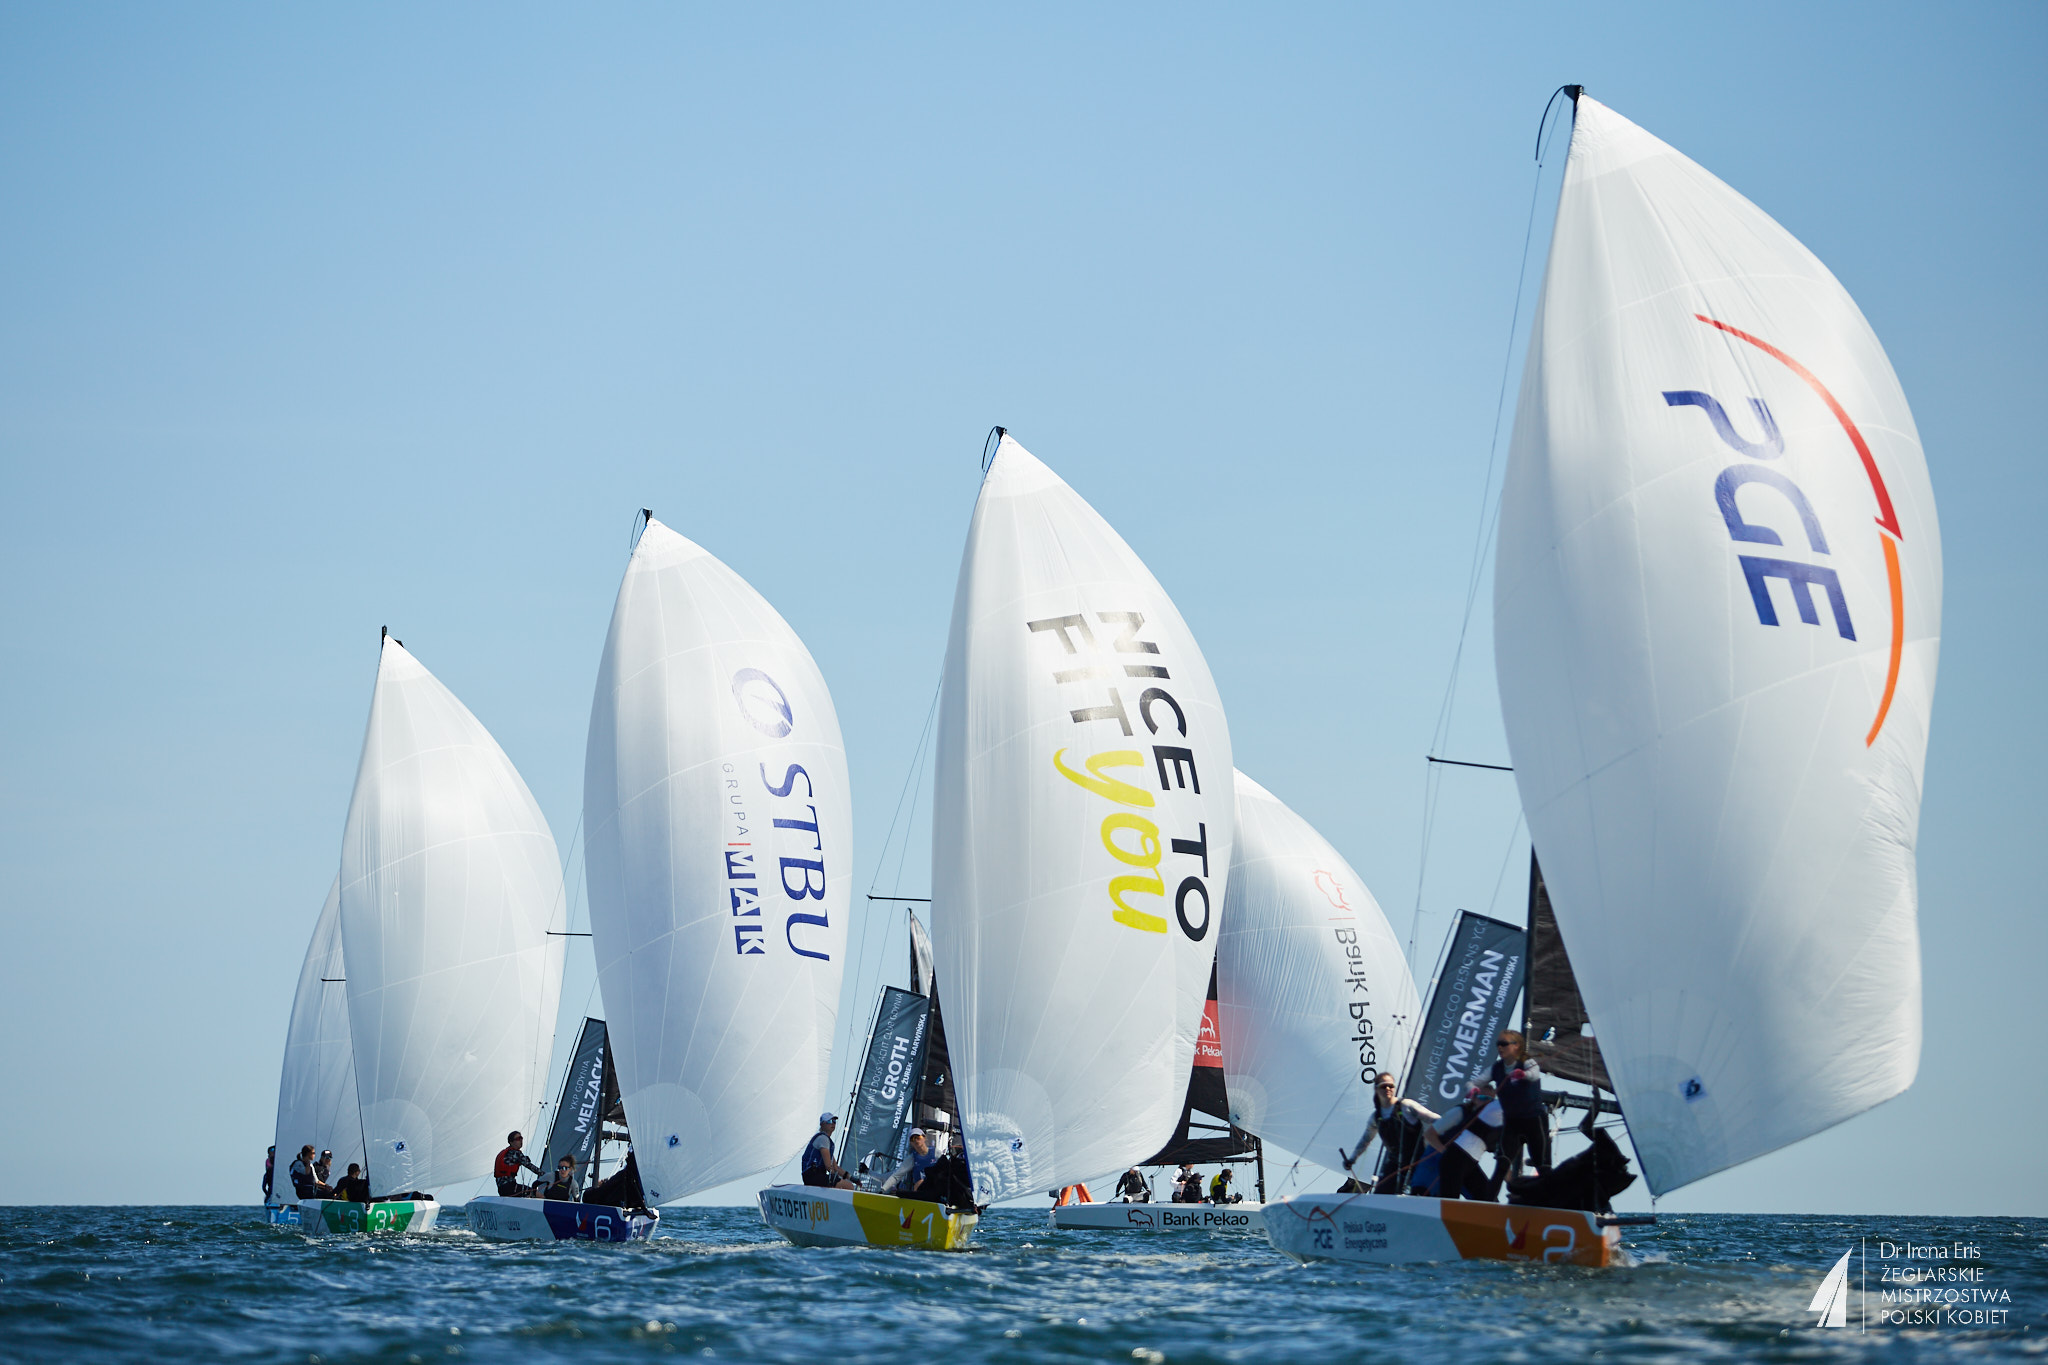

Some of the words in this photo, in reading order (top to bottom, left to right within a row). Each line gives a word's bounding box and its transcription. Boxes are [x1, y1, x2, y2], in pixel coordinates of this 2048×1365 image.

[1661, 389, 1858, 642] PGE
[1026, 613, 1135, 736] FIT
[722, 762, 749, 836] GRUPA
[1096, 611, 1202, 795] NICE
[1170, 822, 1210, 942] TO
[759, 762, 830, 962] STBU
[1053, 747, 1168, 934] you
[1426, 1035, 1448, 1081] ANGELS
[1440, 993, 1461, 1035] LOCCO
[1453, 941, 1480, 992] DESIGNS
[1438, 949, 1505, 1100] CYMERMAN
[1480, 1015, 1499, 1057] OŁOWIAK
[1493, 954, 1520, 1009] BOBROWSKA
[569, 1092, 580, 1110] YKP
[575, 1060, 591, 1093] GDYNIA
[871, 1065, 884, 1089] DOGS
[881, 1036, 910, 1100] GROTH
[859, 1118, 870, 1136] THE
[862, 1088, 878, 1122] BARKING
[349, 1209, 360, 1232] 3
[375, 1209, 387, 1232] 3
[594, 1214, 612, 1241] 6
[793, 1200, 807, 1220] FIT
[808, 1201, 829, 1231] you
[921, 1212, 934, 1242] 1
[1163, 1212, 1200, 1226] Bank
[1204, 1212, 1249, 1226] Pekao
[1343, 1221, 1363, 1233] Polska
[1365, 1221, 1387, 1236] Grupa
[1541, 1224, 1576, 1264] 2
